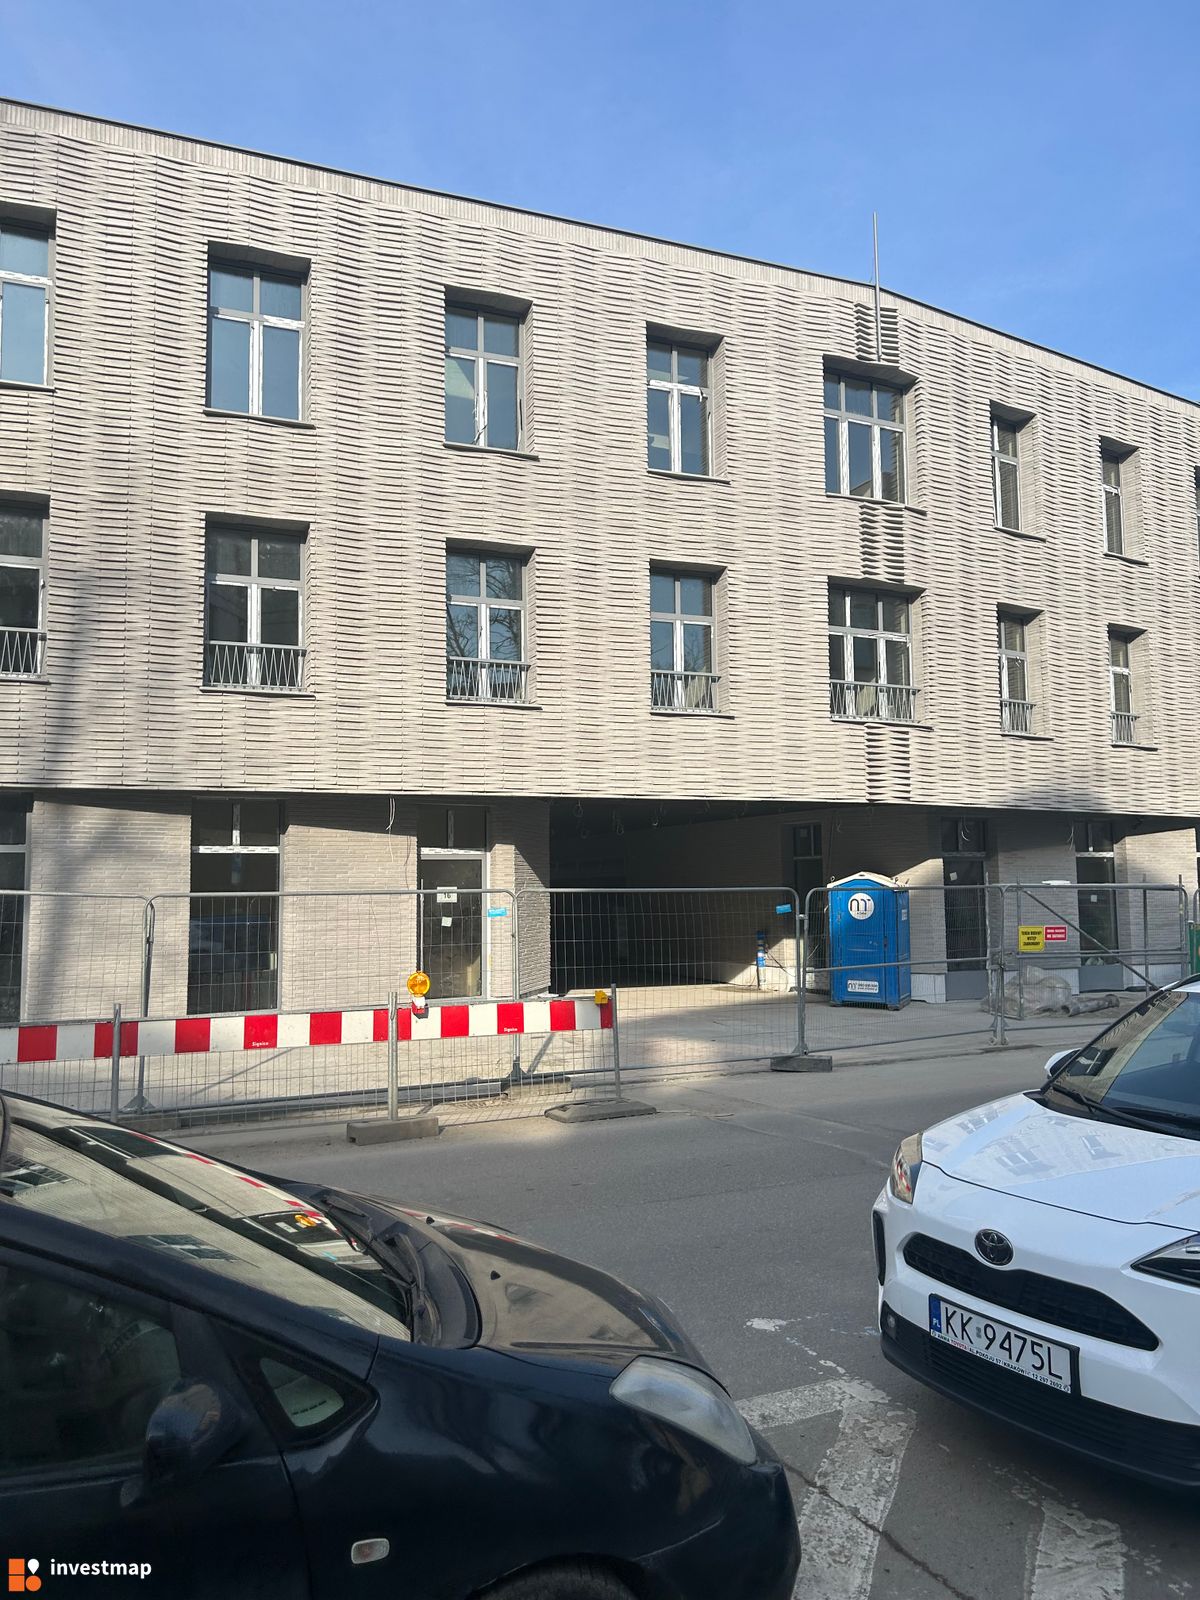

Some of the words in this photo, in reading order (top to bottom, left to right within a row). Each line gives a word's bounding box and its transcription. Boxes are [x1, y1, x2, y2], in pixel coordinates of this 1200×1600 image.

[932, 1317, 941, 1328] PL
[945, 1306, 974, 1345] KK
[983, 1323, 1063, 1380] 9475L
